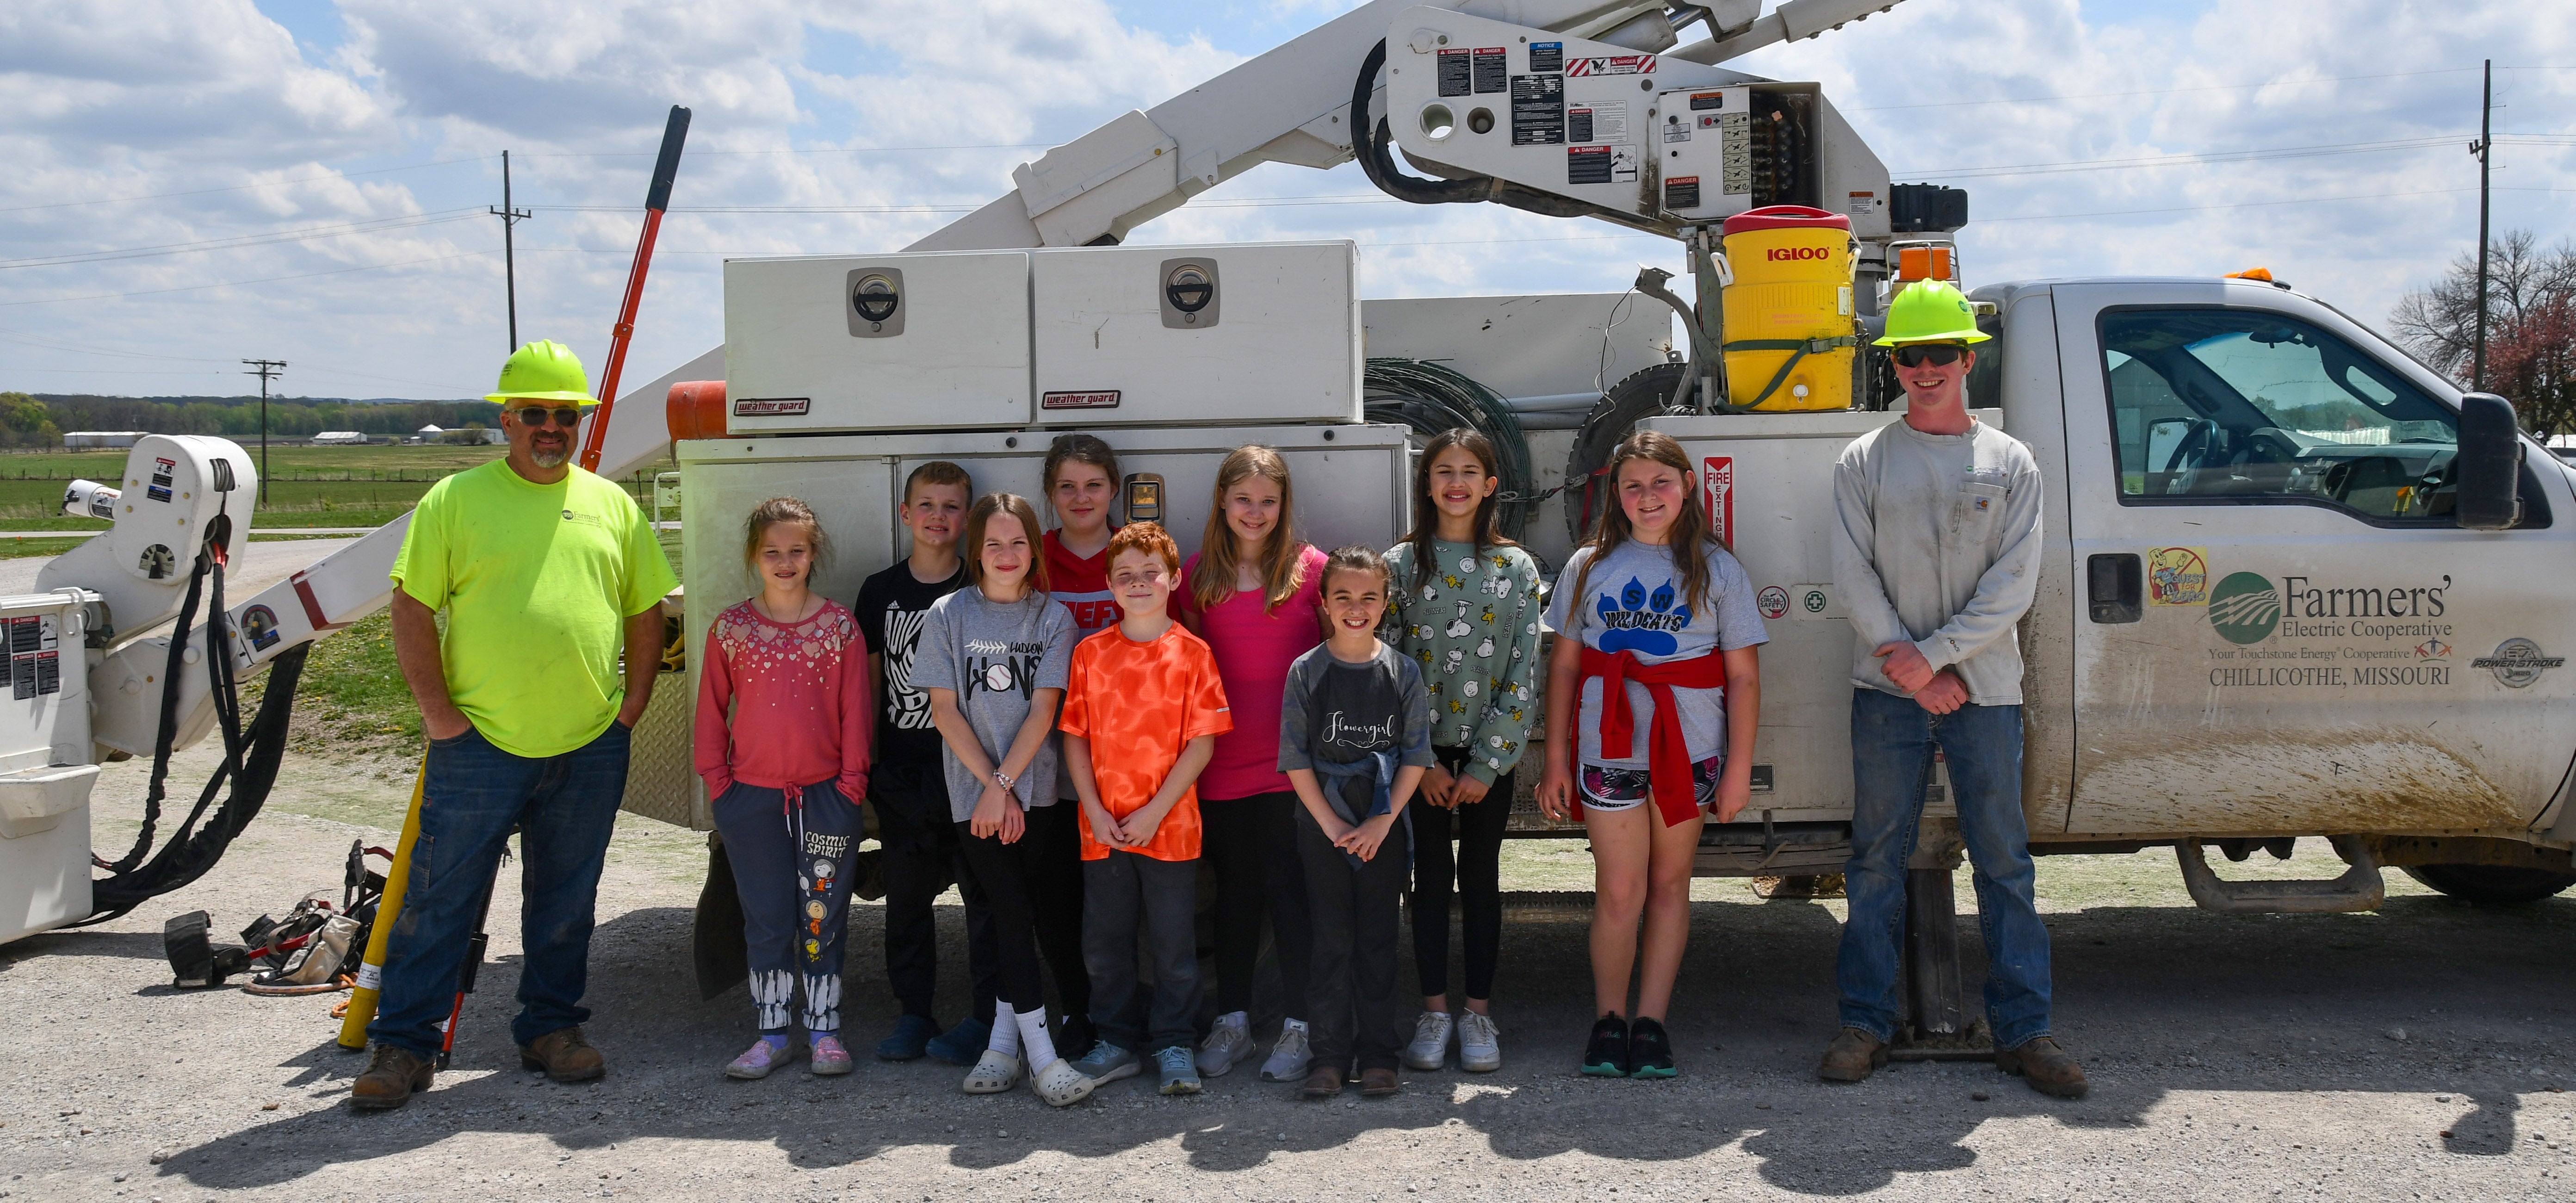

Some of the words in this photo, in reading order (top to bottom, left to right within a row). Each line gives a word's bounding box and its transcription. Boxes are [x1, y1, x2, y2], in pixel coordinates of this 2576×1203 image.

[1767, 248, 1829, 261] IGLOO
[1046, 395, 1086, 403] weather
[1088, 393, 1115, 404] guard
[739, 402, 777, 410] weather
[778, 401, 805, 411] guard
[1708, 472, 1729, 484] FIRE
[574, 511, 601, 522] Farmers'
[2171, 574, 2206, 583] QUEST
[1625, 589, 1641, 605] S
[1651, 594, 1673, 609] W
[2170, 590, 2206, 603] ZERO
[1423, 607, 1446, 615] PEANUTS
[1502, 613, 1514, 638] PEANUTS
[1605, 611, 1683, 632] WILDCATS
[2282, 621, 2345, 637] Electric
[2352, 620, 2452, 640] Cooperative
[1010, 641, 1043, 655] LUDLOW
[2209, 648, 2235, 659] Your
[2238, 647, 2297, 659] Touchstone
[2343, 648, 2409, 661] Cooperative
[2516, 659, 2564, 667] STROKE
[2210, 668, 2347, 689] CHILLICOTHE,
[2353, 667, 2450, 685] MISSOURI
[1322, 710, 1395, 744] Flowergirl
[805, 831, 850, 847] COSMIC
[806, 843, 846, 858] SPIRIT
